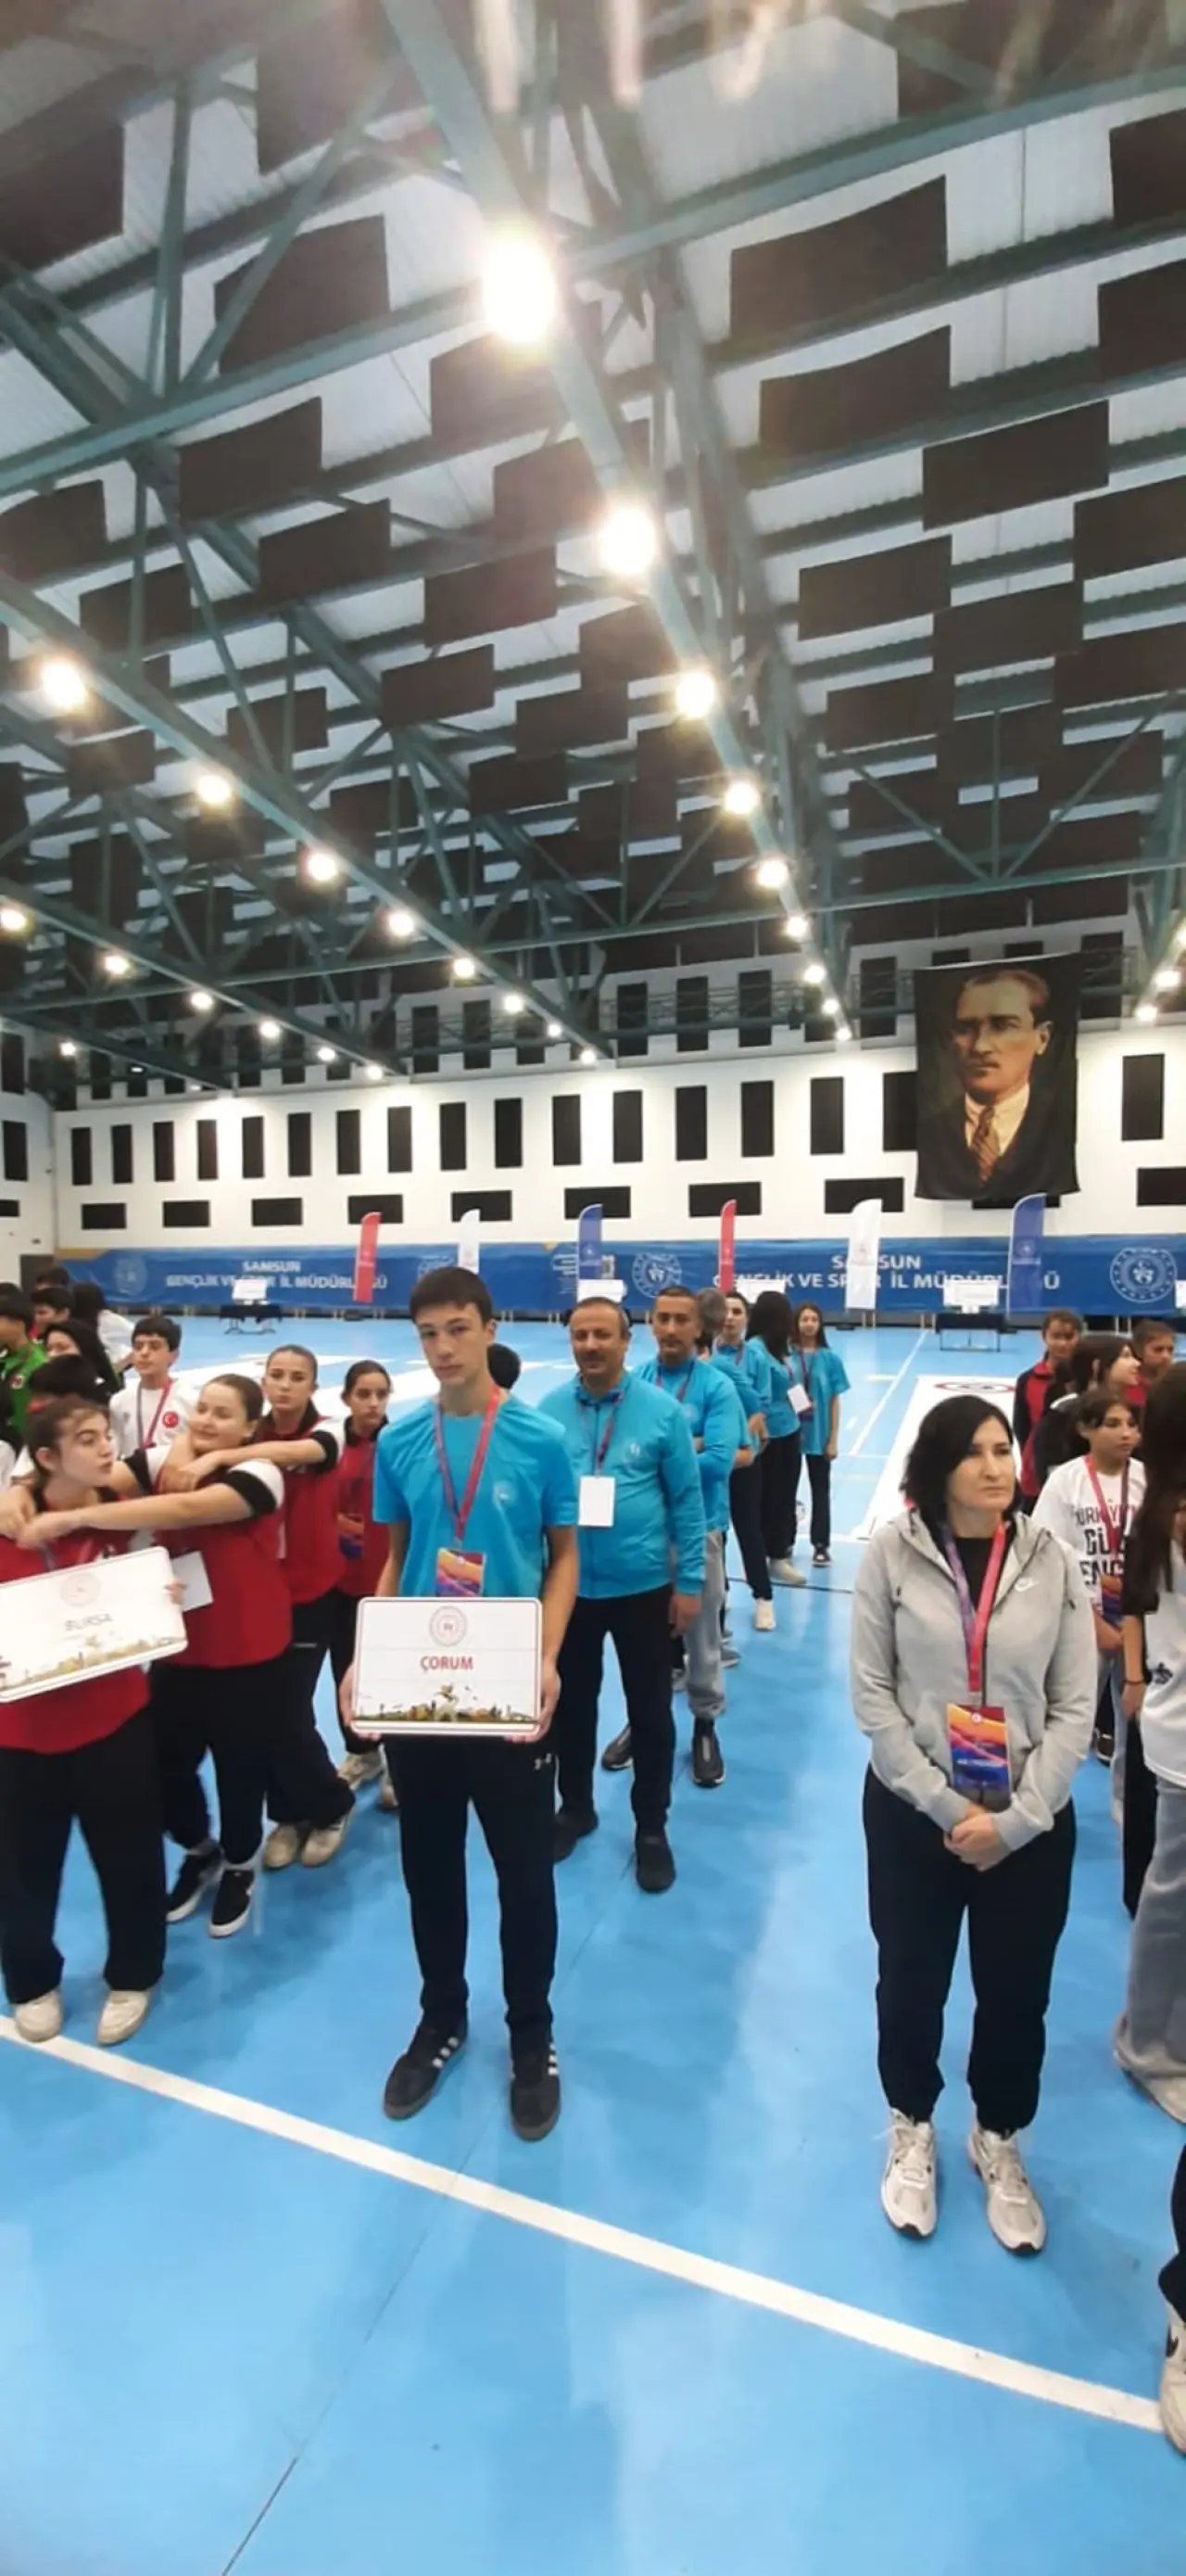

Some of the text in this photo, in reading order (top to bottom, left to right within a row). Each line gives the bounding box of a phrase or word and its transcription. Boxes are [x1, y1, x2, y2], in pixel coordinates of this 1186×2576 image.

[243, 1261, 301, 1273] SAMSUN
[831, 1254, 921, 1270] SSUN
[798, 1274, 824, 1288] VE
[891, 1270, 909, 1288] İL
[421, 1656, 473, 1673] ÇORUM
